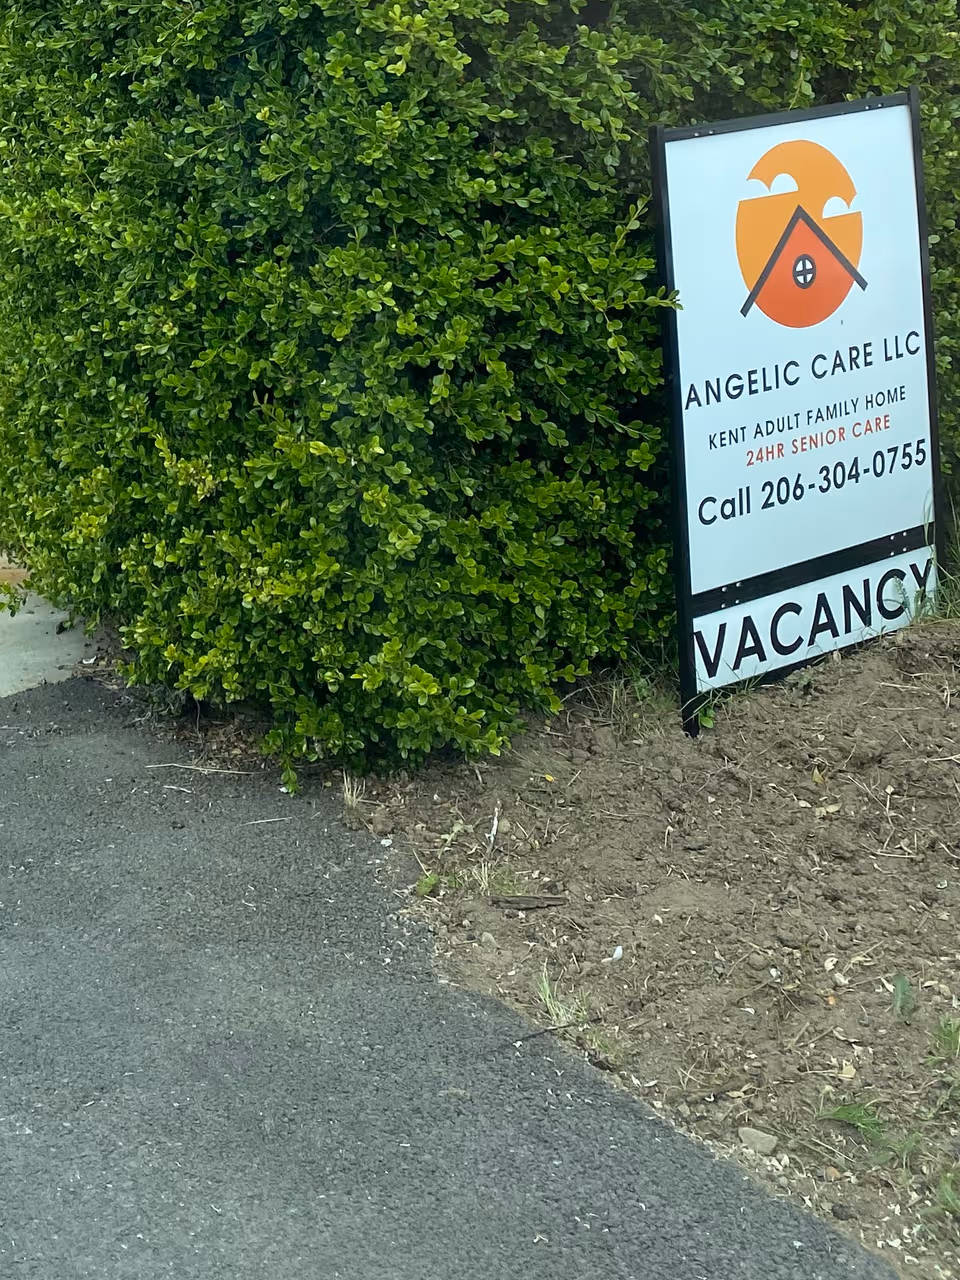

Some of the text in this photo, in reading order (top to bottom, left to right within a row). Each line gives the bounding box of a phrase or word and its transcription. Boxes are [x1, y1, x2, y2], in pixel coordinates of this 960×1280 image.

[684, 330, 921, 410] ANGELIC CARE LLC
[708, 385, 907, 451] KENT ADULT FAMILY HOME
[746, 414, 891, 467] 24HR SENIOR CARE
[697, 438, 927, 526] Call 206-304-0755
[693, 558, 934, 679] VACANCY
